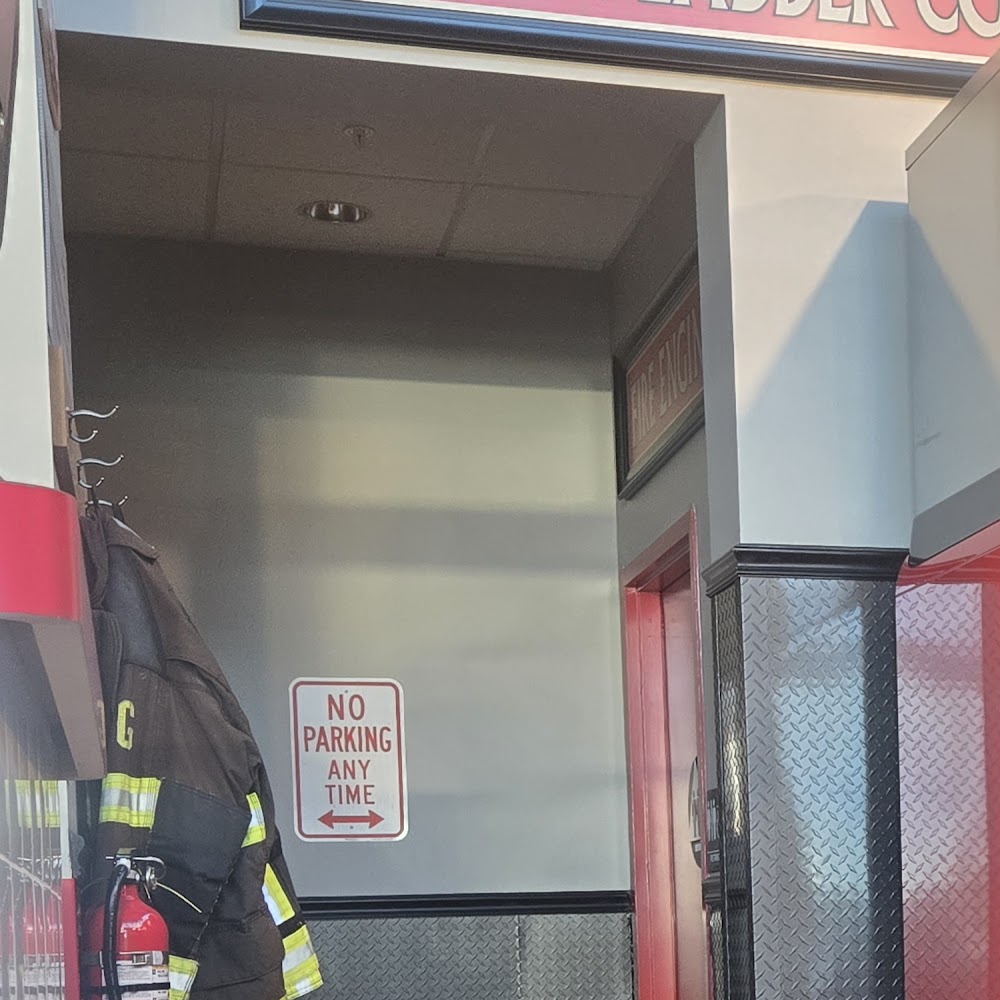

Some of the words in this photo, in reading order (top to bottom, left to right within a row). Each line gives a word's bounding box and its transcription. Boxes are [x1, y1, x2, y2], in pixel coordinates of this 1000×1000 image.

[327, 694, 365, 721] NO
[303, 726, 392, 752] PARKING
[328, 759, 371, 780] ANY
[324, 784, 375, 805] TIME
